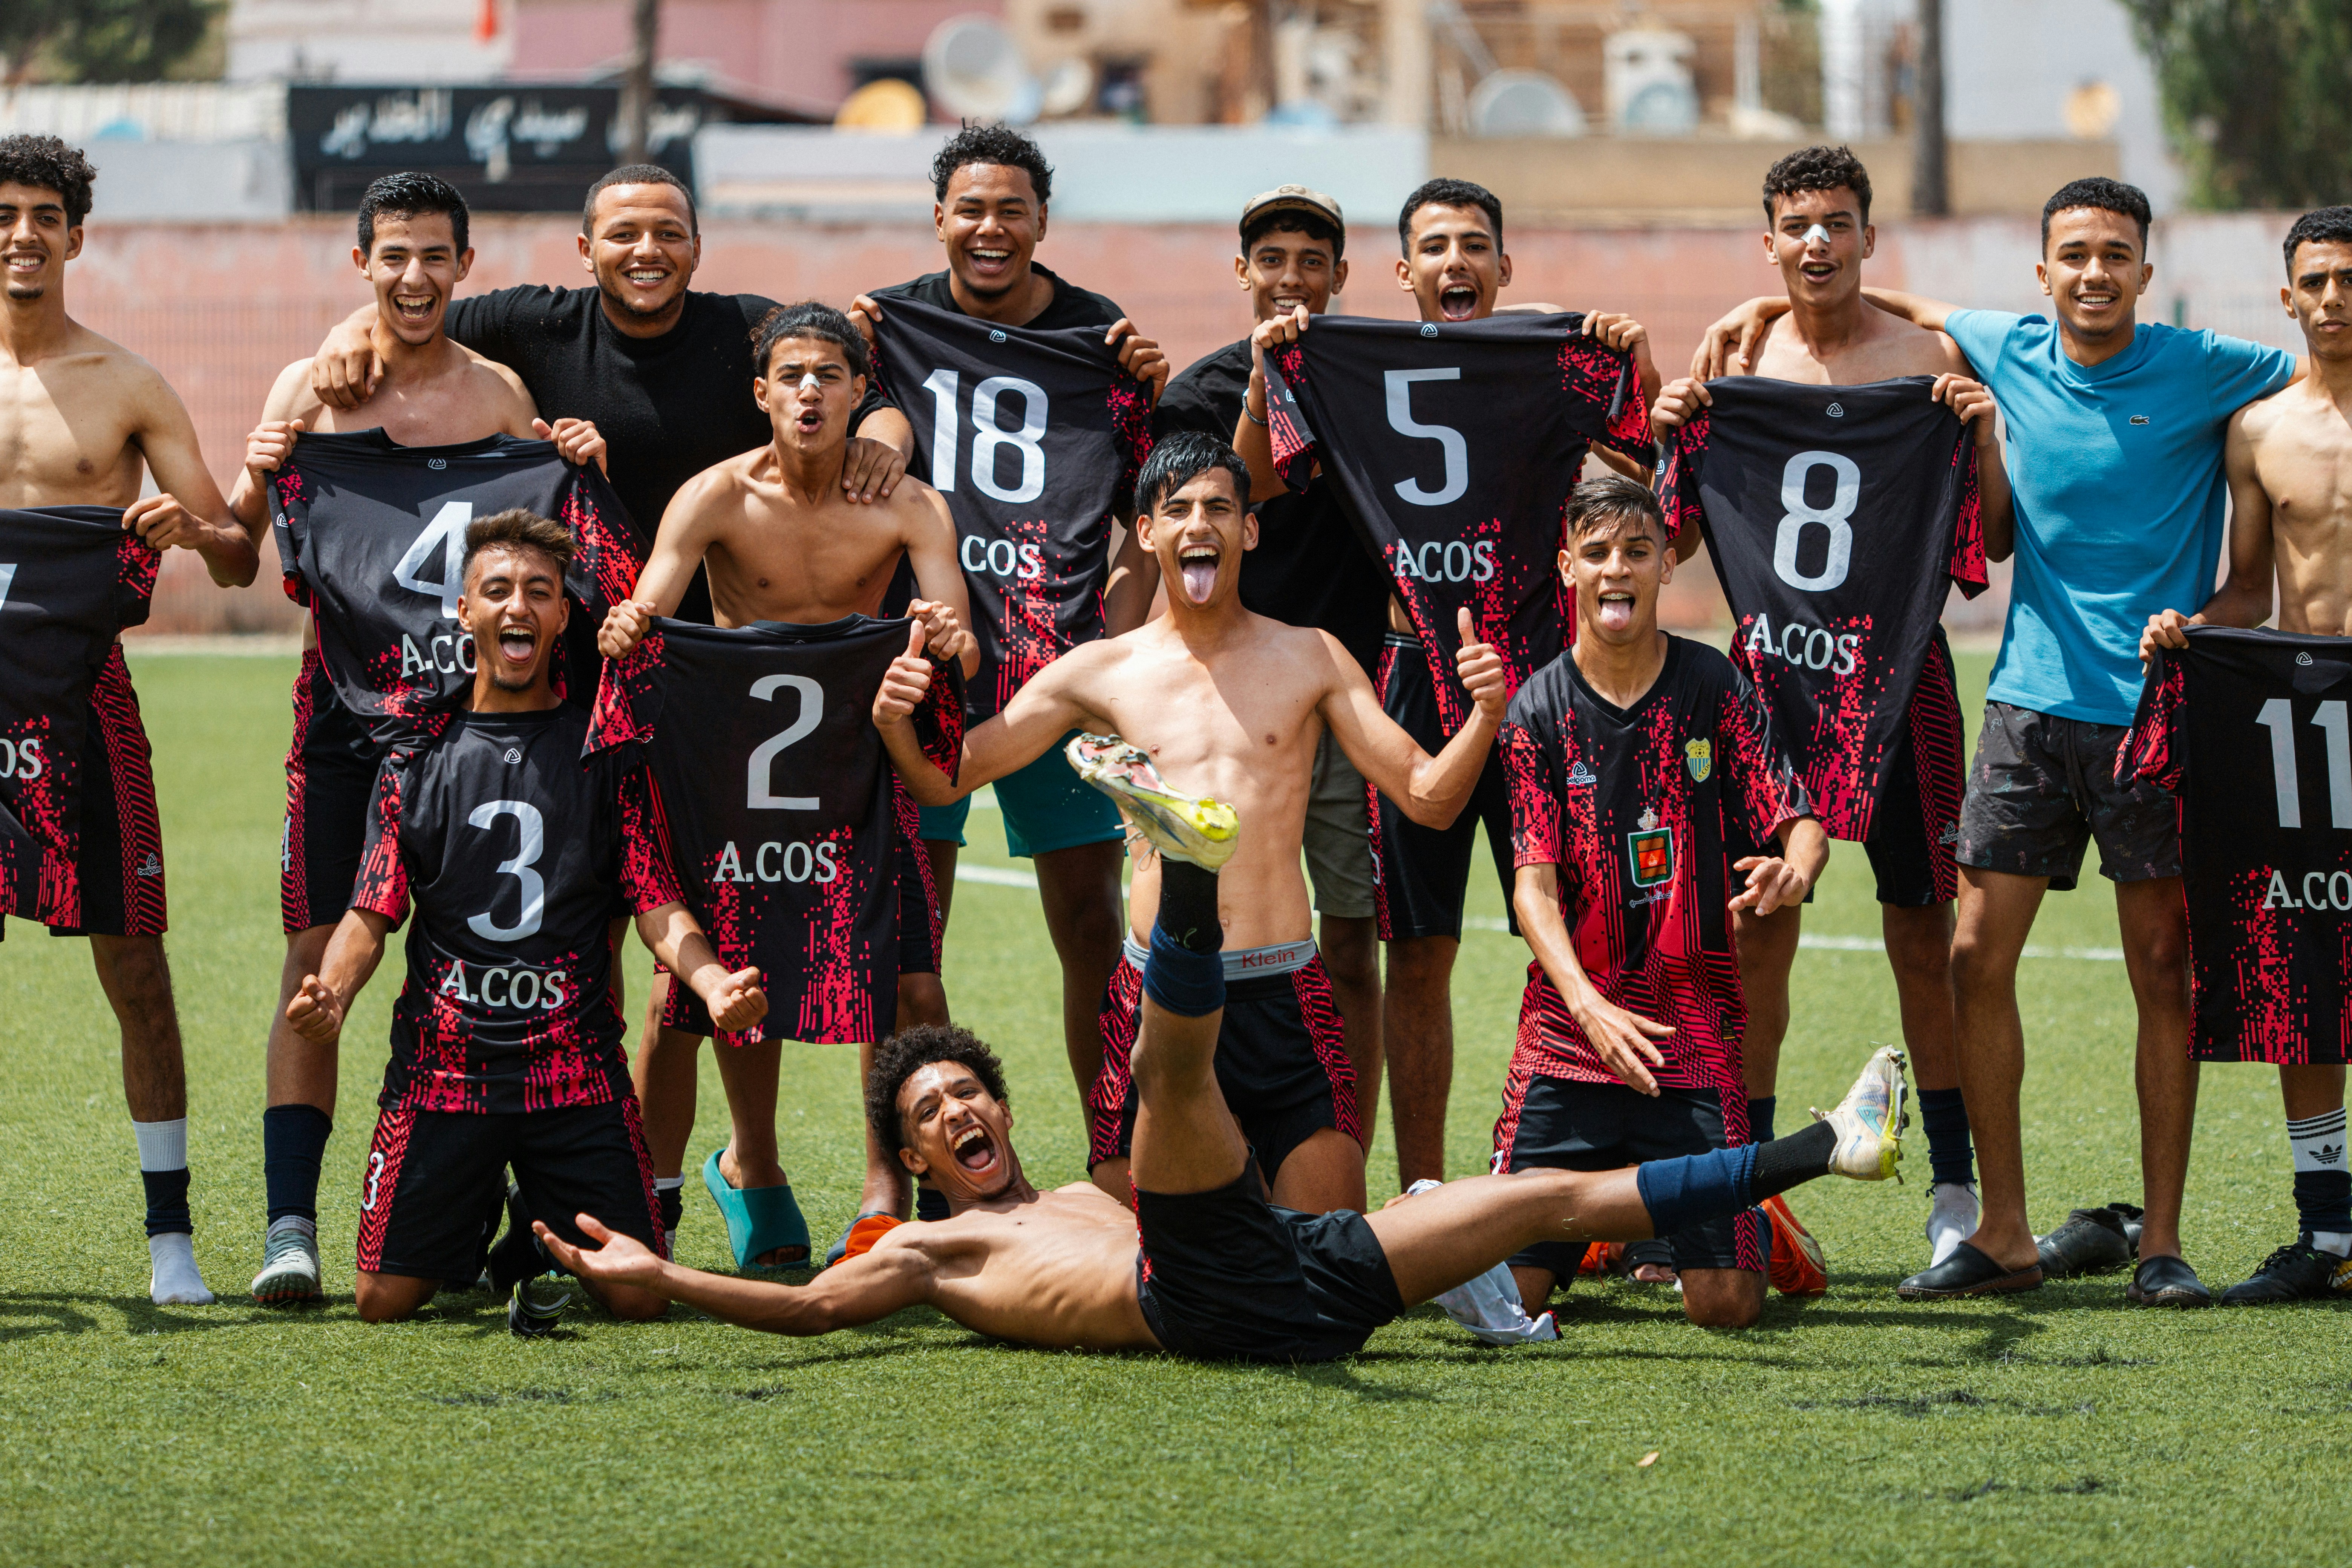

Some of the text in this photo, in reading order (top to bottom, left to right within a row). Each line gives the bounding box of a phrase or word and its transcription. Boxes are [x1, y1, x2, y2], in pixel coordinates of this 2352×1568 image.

[922, 369, 1049, 504] 18
[1384, 367, 1468, 506] 5
[1773, 450, 1861, 591] 8
[392, 501, 473, 619] 4
[961, 534, 1040, 579] COS
[400, 633, 478, 678] A.CO
[1745, 613, 1858, 675] A.COS
[747, 674, 824, 810] 2
[2255, 698, 2352, 829] 11
[467, 800, 544, 942] 3
[713, 841, 837, 883] A.COS
[2262, 870, 2352, 910] A.CO
[438, 960, 566, 1009] A.COS
[1242, 949, 1295, 968] Klein
[362, 1152, 384, 1211] 3
